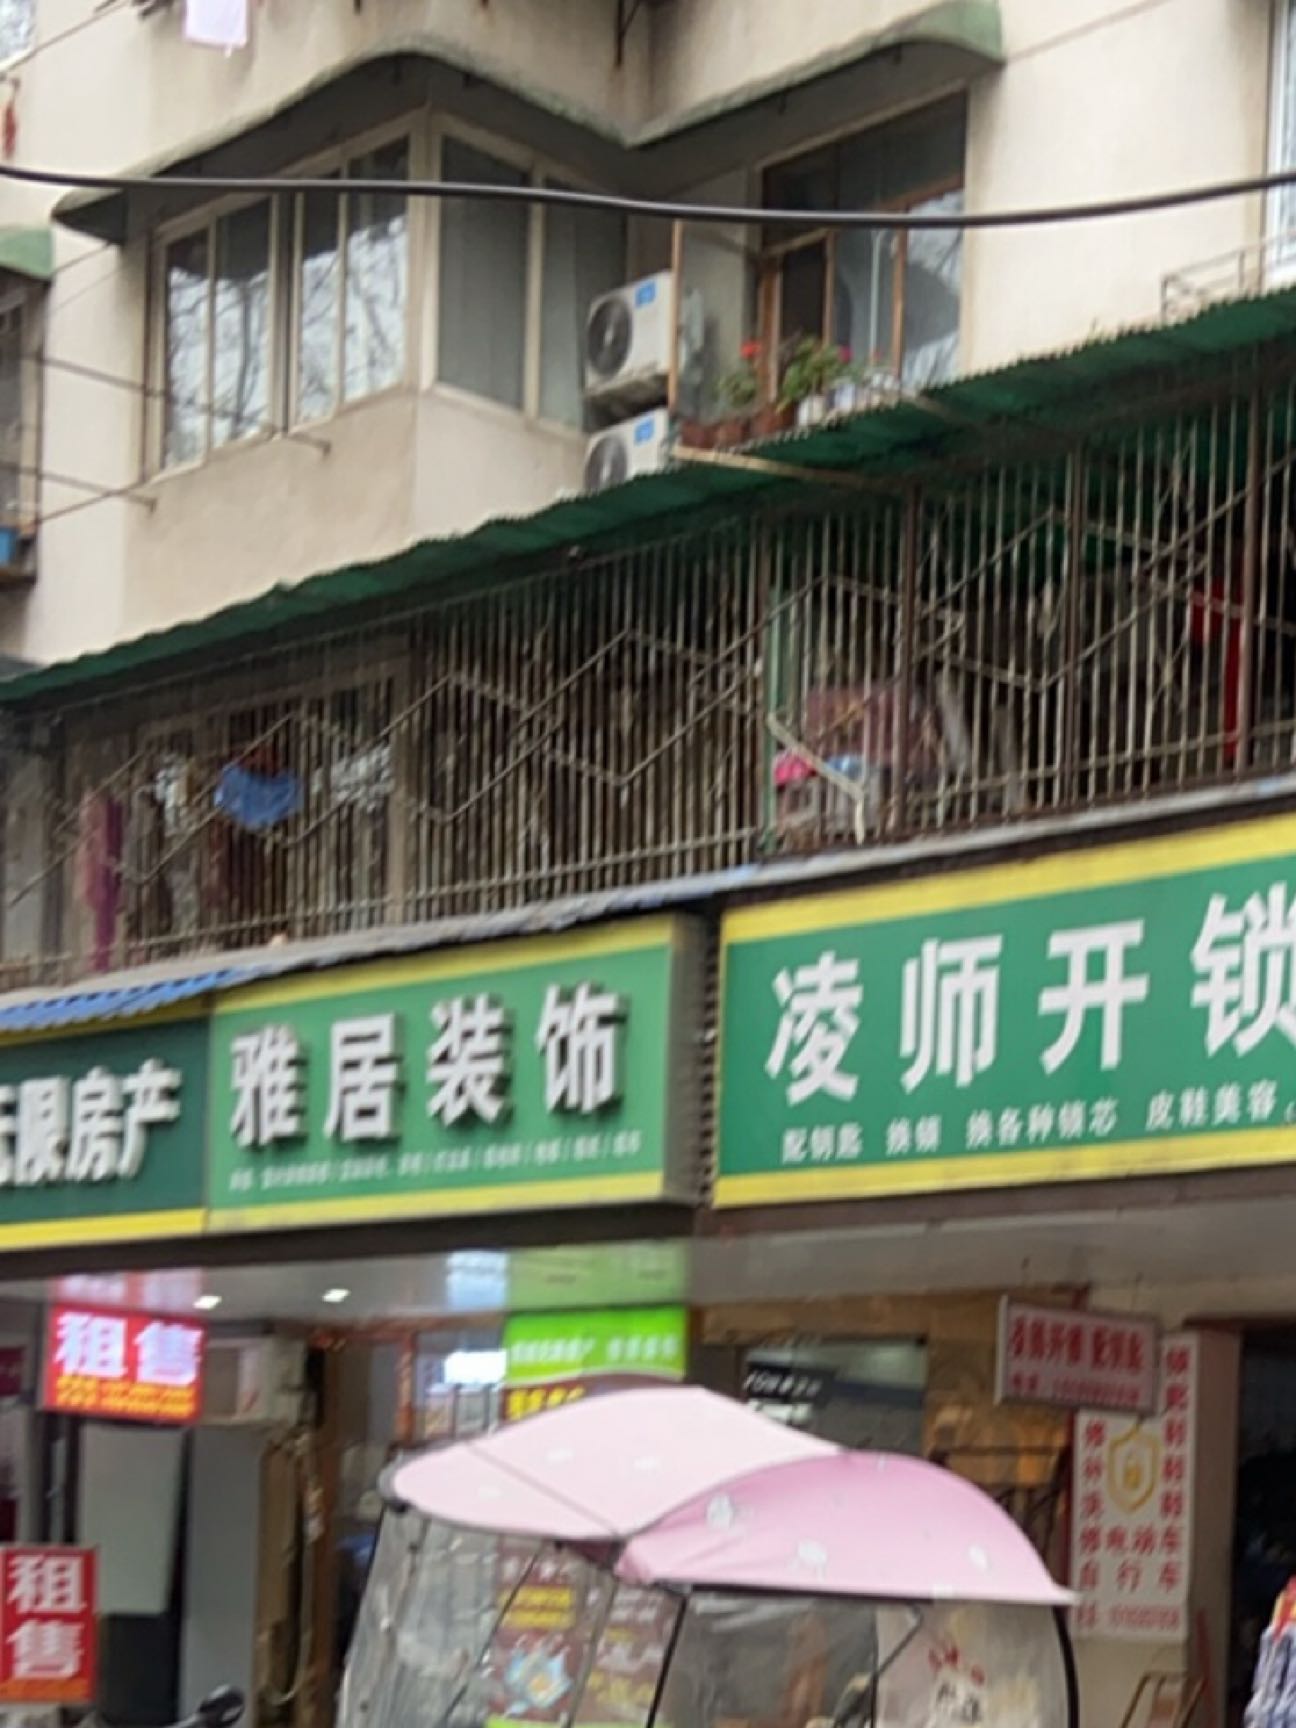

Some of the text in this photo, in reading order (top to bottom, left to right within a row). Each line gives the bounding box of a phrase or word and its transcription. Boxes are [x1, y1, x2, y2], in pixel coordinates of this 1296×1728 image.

[231, 981, 627, 1149] 雅居装饰
[782, 1121, 863, 1165] 配钥匙
[1146, 1079, 1278, 1131] 皮鞋美容
[53, 1311, 204, 1386] 租售
[6, 1553, 87, 1680] 租售
